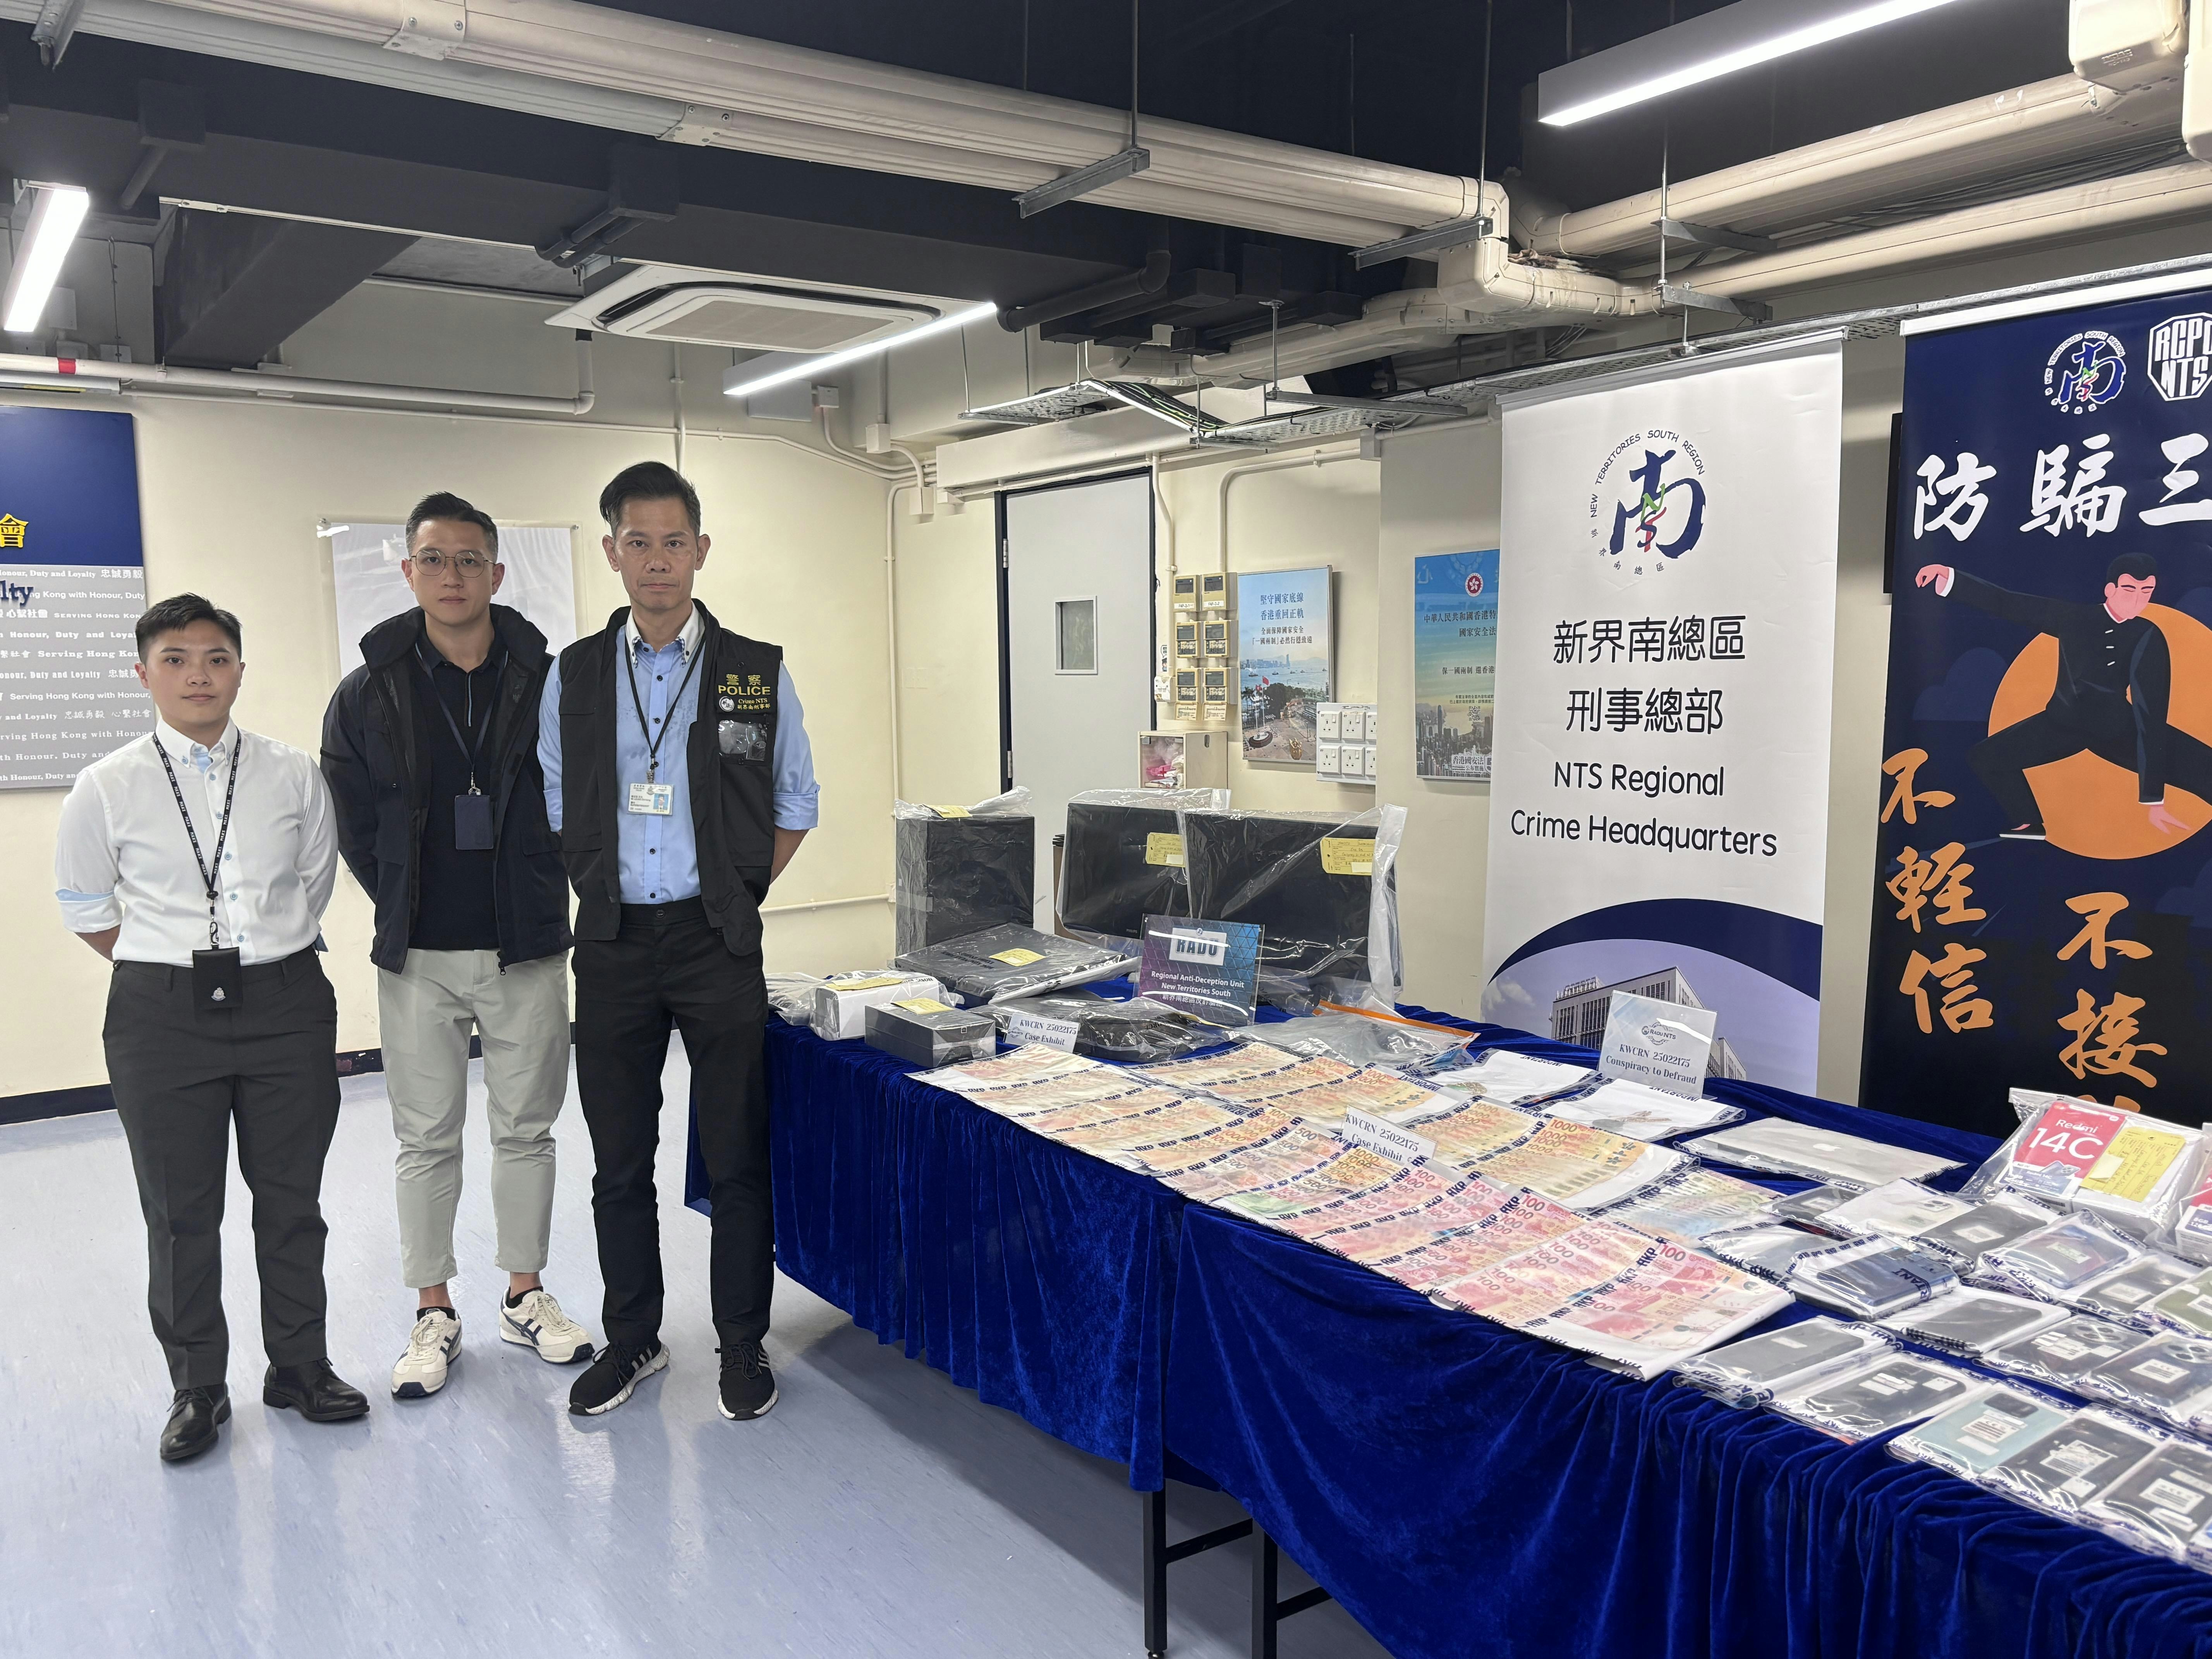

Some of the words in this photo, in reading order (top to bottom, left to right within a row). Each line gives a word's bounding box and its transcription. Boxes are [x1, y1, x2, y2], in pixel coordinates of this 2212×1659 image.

[2155, 318, 2212, 361] RCP
[2160, 356, 2209, 398] NTS
[1590, 494, 1599, 518] NEW
[1595, 433, 1641, 485] TERRITORIES
[1647, 430, 1679, 442] SOUTH
[1682, 440, 1705, 475] REGION
[1914, 433, 2212, 542] 防騙三
[0, 514, 29, 549] 會
[1261, 592, 1304, 605] 堅守國家底線
[1261, 608, 1304, 620] 香港重回正軌
[1261, 625, 1304, 635] 全面保障國家安全
[1553, 615, 1747, 664] 新界南總區
[86, 650, 115, 658] Hong
[726, 674, 761, 685] 警察
[718, 684, 771, 696] POLICE
[112, 709, 152, 718] 心繫社會
[1566, 687, 1723, 735] 刑事總部
[31, 732, 57, 740] Hong
[1554, 761, 1602, 790] NTS
[1611, 764, 1724, 799] Regional
[1511, 809, 1581, 841] Crime
[1588, 815, 1778, 857] Headquarters
[1151, 971, 1179, 982] Regional
[1180, 974, 1229, 986] Anti-Deception
[1230, 980, 1245, 988] Unit
[1177, 984, 1210, 994] Territories
[1211, 988, 1231, 997] South
[2057, 892, 2168, 1113] 不接
[1020, 1019, 1044, 1030] KWCRN
[1046, 1023, 1077, 1035] 25022175
[1025, 1032, 1040, 1041] Case
[1041, 1035, 1065, 1046] Exhibit
[1619, 1043, 1650, 1058] KWCRN
[1652, 1051, 1691, 1068] 25022175
[1606, 1055, 1651, 1075] Conspiracy
[1653, 1066, 1661, 1076] to
[1664, 1069, 1697, 1084] Defraud
[1398, 1075, 1441, 1092] IMPORTANT
[1346, 1114, 1377, 1134] KWCRN
[1379, 1128, 1419, 1152] 25022175
[1551, 1119, 1578, 1132] 1000
[2055, 1119, 2099, 1134] Redmi
[1295, 1127, 1317, 1141] 500
[1278, 1140, 1300, 1151] 500
[1352, 1133, 1371, 1149] Case
[1373, 1142, 1403, 1162] Exhibit
[2028, 1127, 2105, 1159] 14C
[1240, 1151, 1262, 1162] 500
[1415, 1170, 1435, 1182] 100
[1522, 1195, 1545, 1211] 100
[1512, 1207, 1534, 1219] 100
[1549, 1242, 1574, 1258] 100
[1659, 1244, 1686, 1262] 100
[1477, 1276, 1501, 1291] 100
[1491, 1268, 1515, 1283] 100
